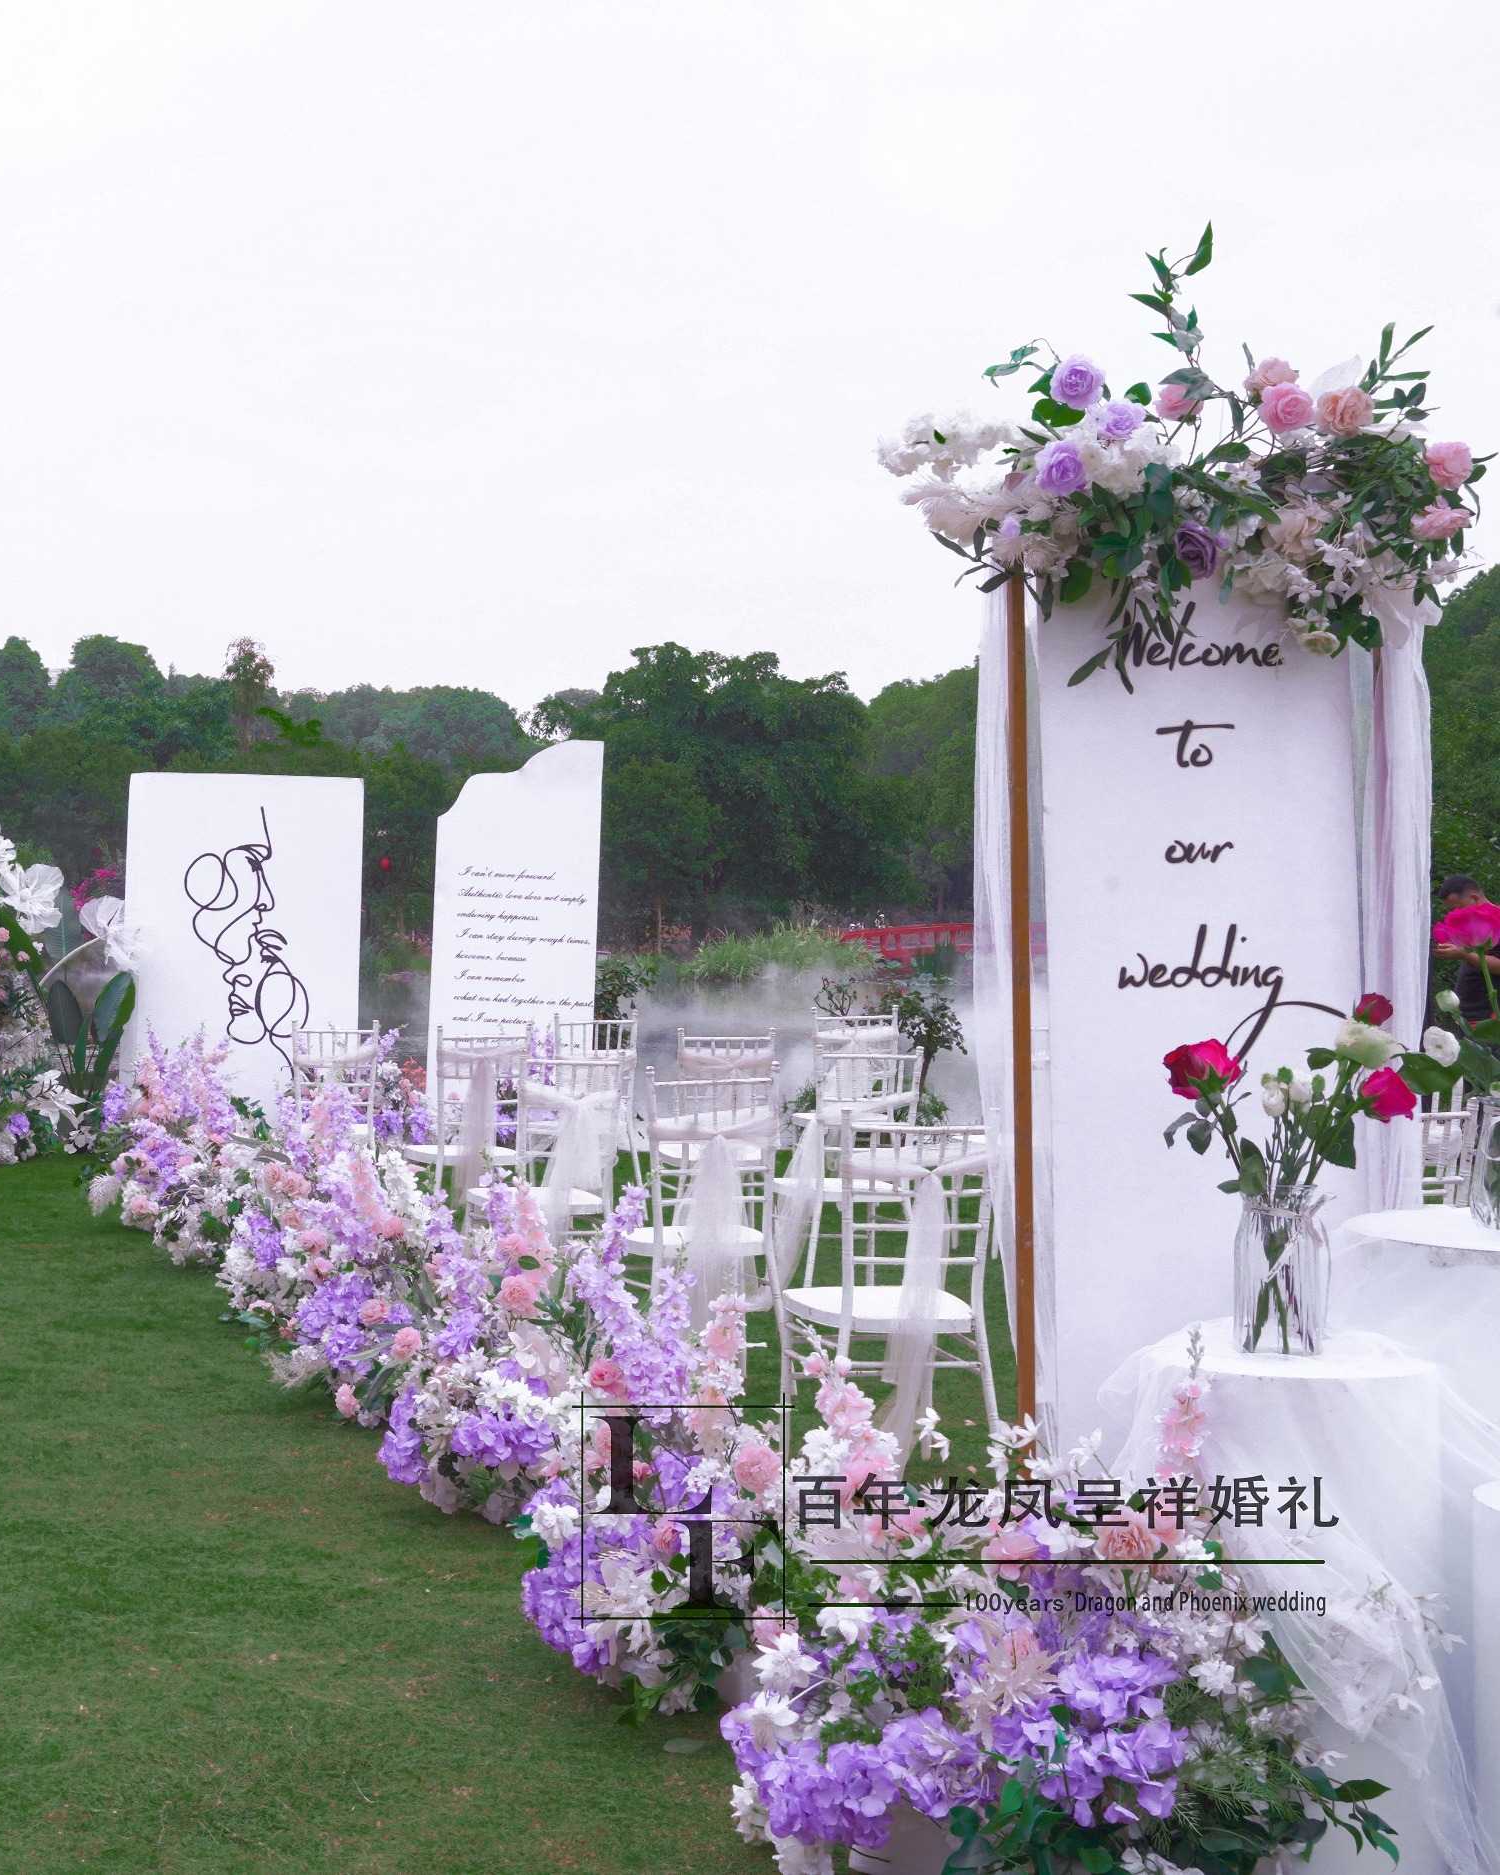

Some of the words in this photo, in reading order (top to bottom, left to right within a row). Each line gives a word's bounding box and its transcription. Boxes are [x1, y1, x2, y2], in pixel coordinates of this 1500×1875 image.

[1115, 600, 1285, 672] Welcome
[1164, 839, 1235, 864] our
[1118, 923, 1346, 1062] wedding
